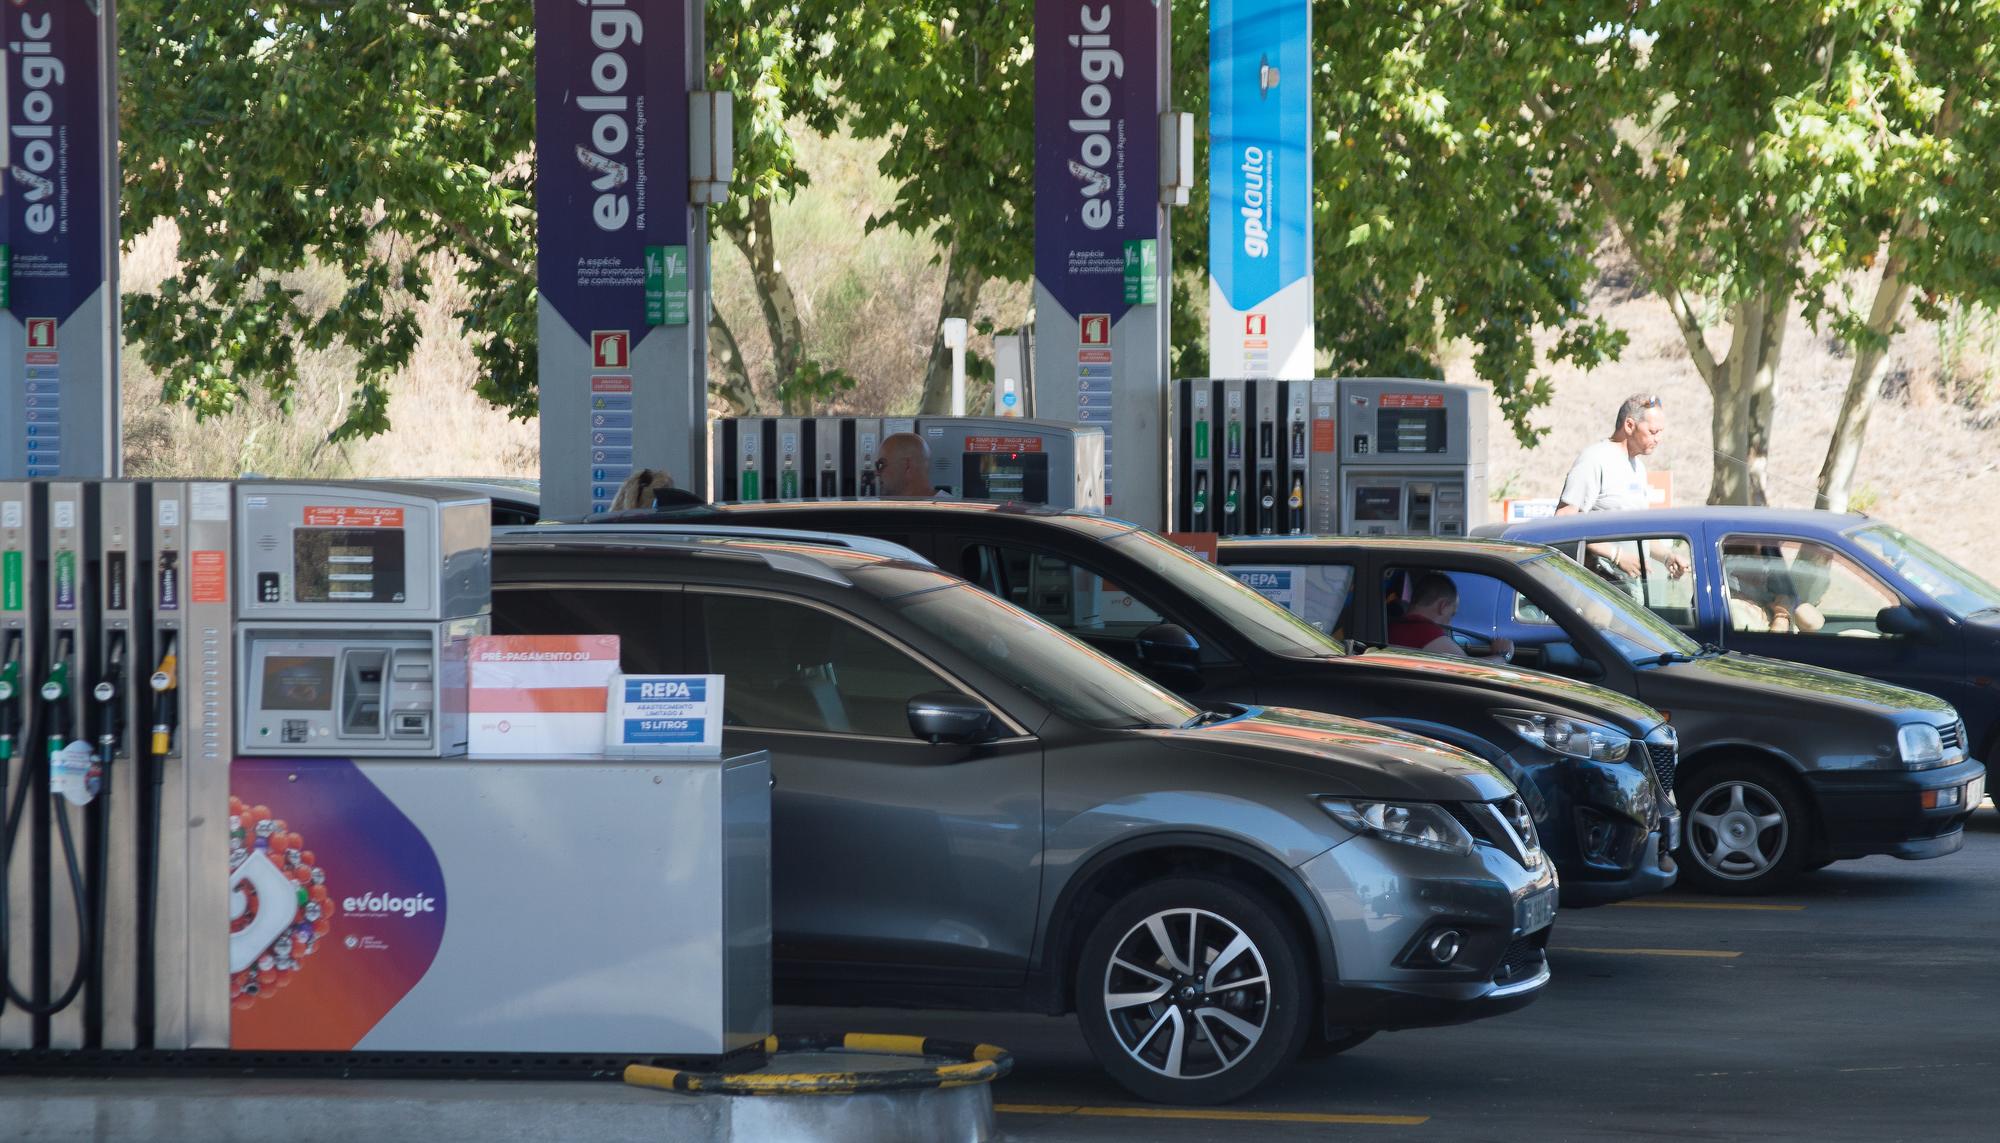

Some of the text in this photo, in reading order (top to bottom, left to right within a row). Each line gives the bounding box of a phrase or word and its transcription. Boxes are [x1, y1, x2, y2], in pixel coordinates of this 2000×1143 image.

[8, 12, 66, 235] evologic
[636, 95, 647, 132] Agents
[1067, 4, 1125, 230] evologic
[636, 135, 645, 156] Fuel
[1117, 119, 1126, 149] Agents
[1117, 150, 1125, 169] Fuel
[59, 176, 69, 217] Intelligent
[636, 159, 647, 212] Intelligent
[1117, 170, 1127, 213] Intelligent
[1240, 146, 1269, 258] gplauto
[336, 515, 345, 525] 2
[573, 651, 590, 660] OU
[641, 682, 690, 697] REPA
[640, 721, 688, 729] 15 LITROS
[342, 891, 435, 917] evologic
